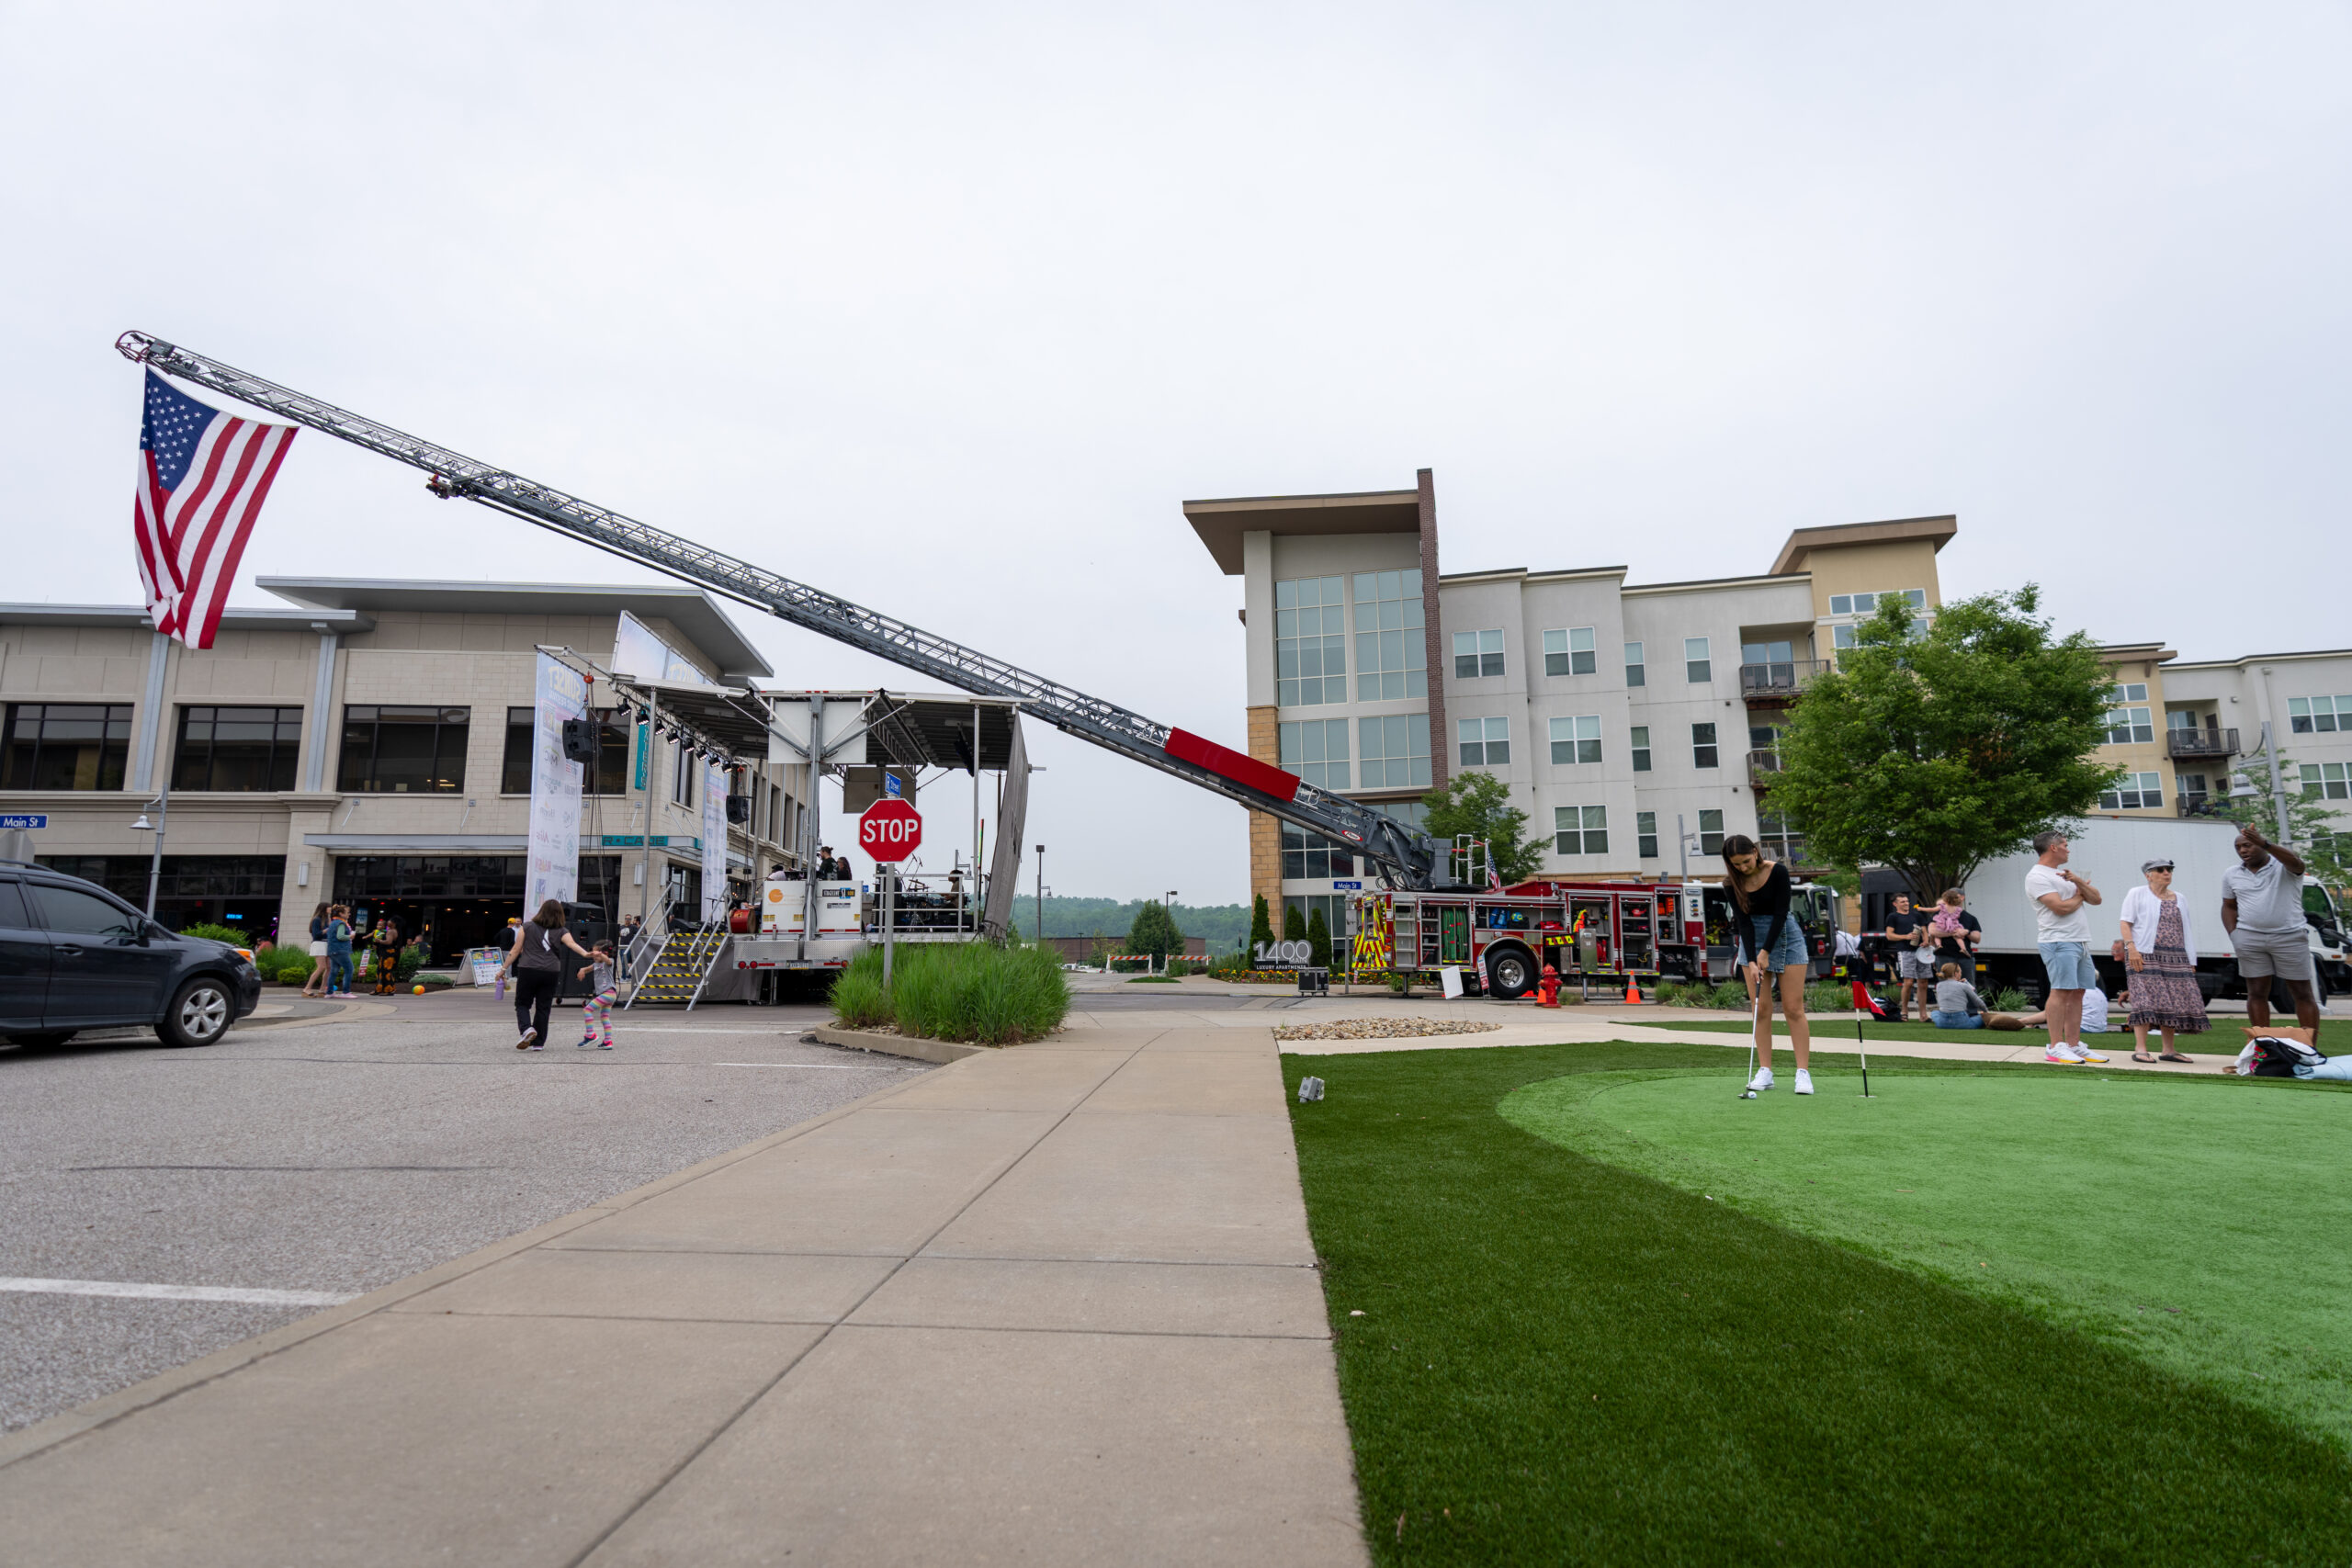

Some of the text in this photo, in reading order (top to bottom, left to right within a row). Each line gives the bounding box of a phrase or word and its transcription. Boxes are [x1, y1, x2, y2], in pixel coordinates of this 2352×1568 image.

[3, 817, 39, 828] Main St
[863, 818, 919, 843] STOP
[1255, 941, 1310, 964] 1400
